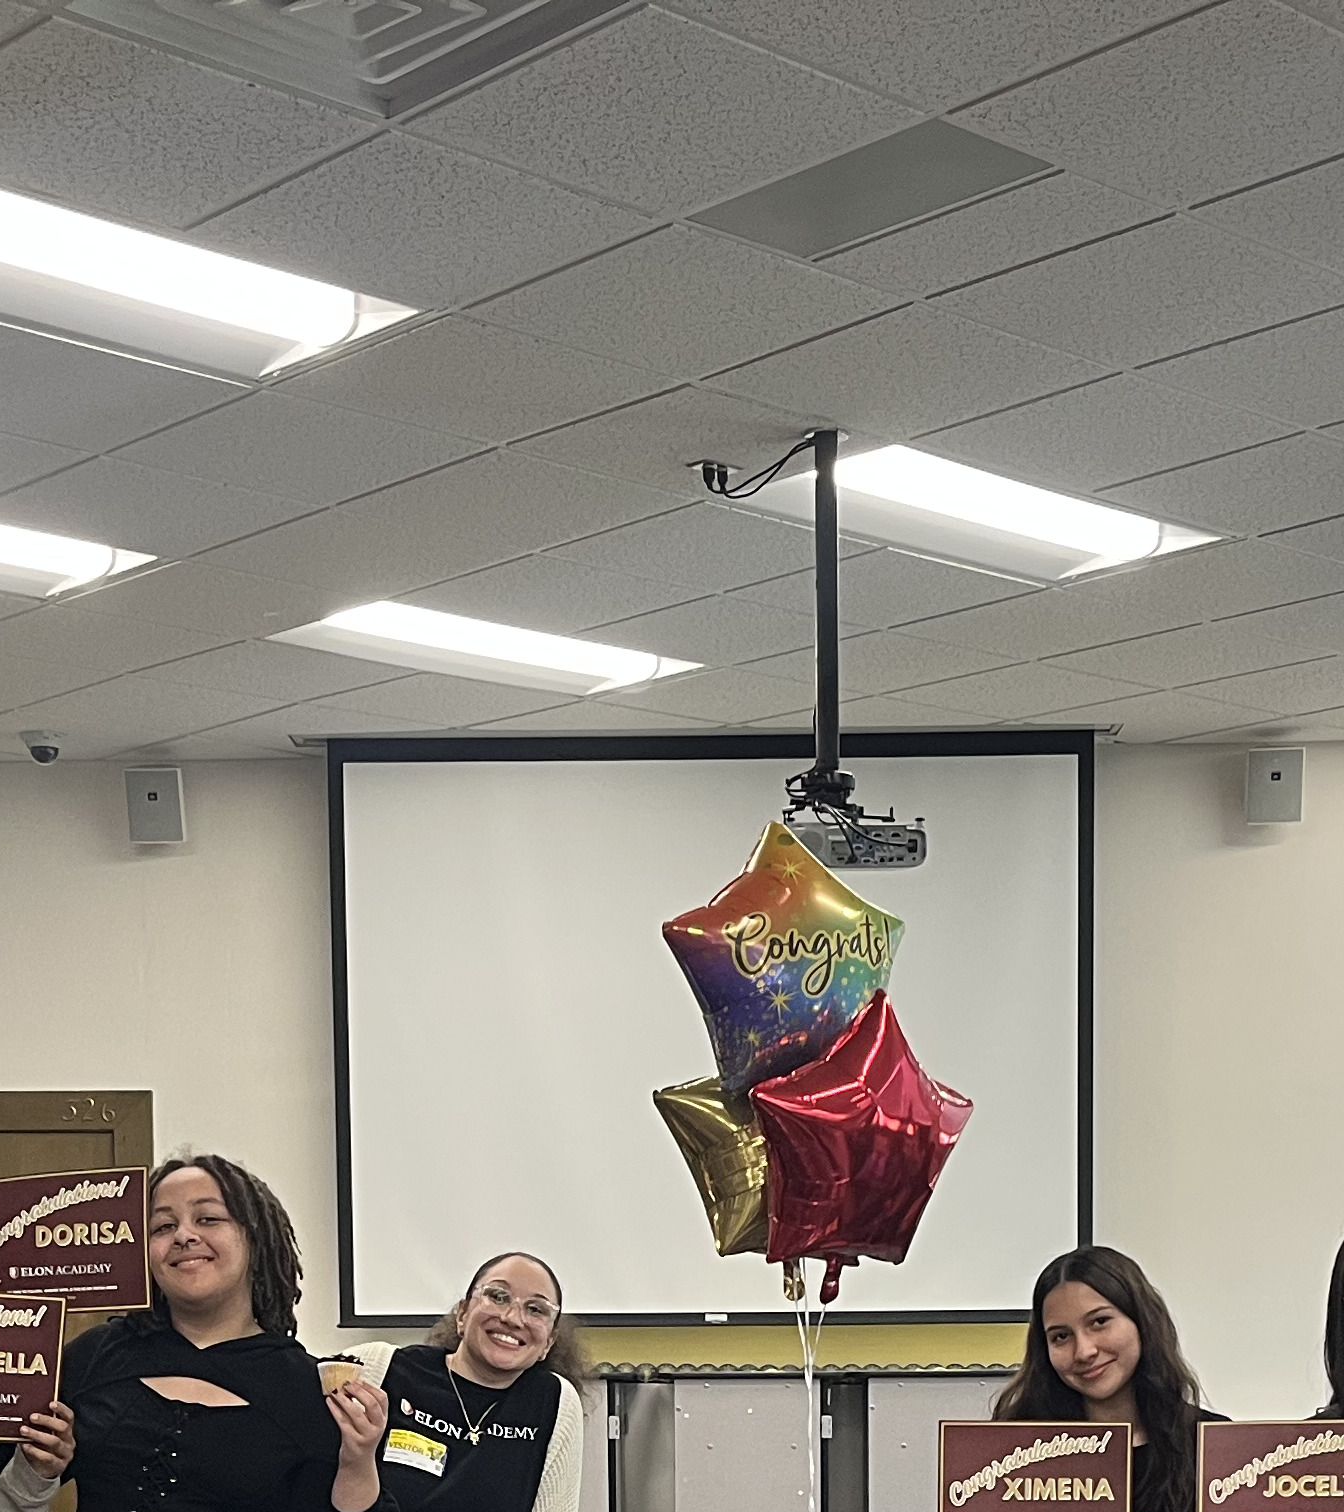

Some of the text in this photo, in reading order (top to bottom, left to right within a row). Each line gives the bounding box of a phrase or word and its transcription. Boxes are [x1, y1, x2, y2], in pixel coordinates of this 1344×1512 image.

[725, 911, 892, 996] Congrats!
[35, 1221, 134, 1248] DORISA
[21, 1263, 112, 1278] ELON ACADEMY
[415, 1409, 462, 1440] ELON
[949, 1431, 1113, 1506] Congratulations!
[1002, 1477, 1115, 1501] XIMENA
